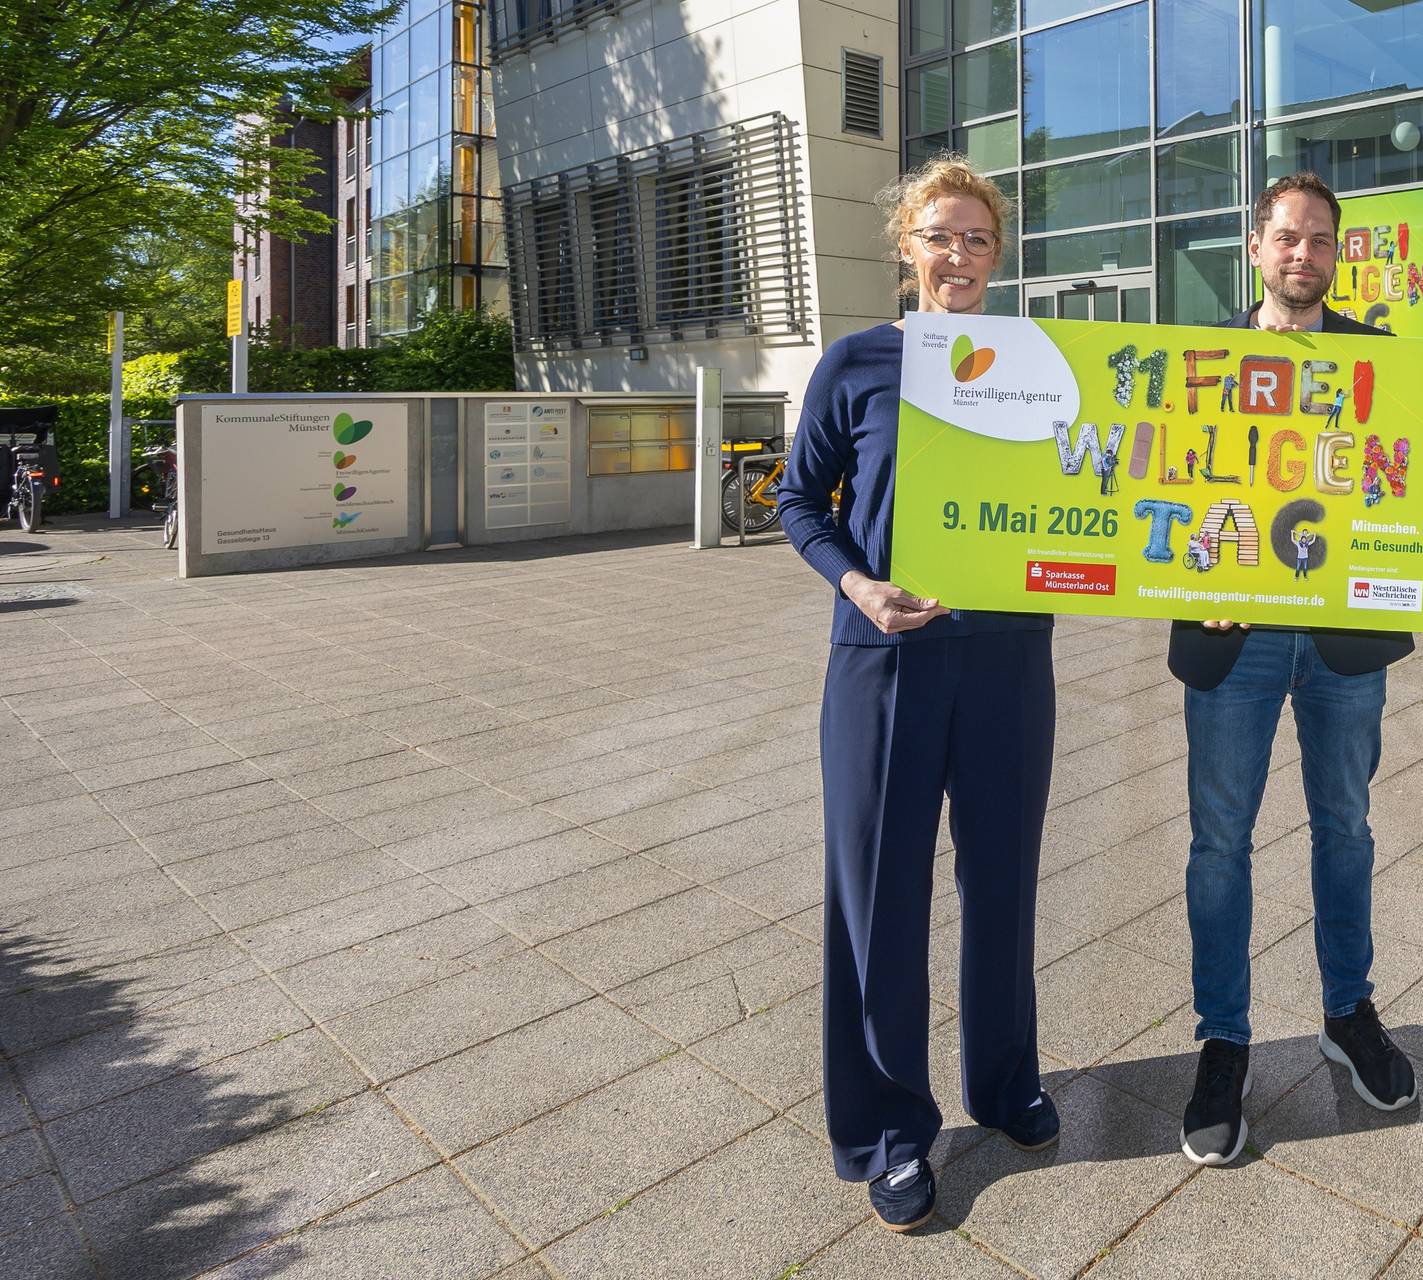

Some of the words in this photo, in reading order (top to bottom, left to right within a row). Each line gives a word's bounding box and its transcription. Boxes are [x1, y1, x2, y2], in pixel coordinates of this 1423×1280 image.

[1345, 223, 1409, 262] REI
[923, 332, 949, 342] Stiftung
[921, 340, 948, 349] Siverdes
[1183, 349, 1375, 424] FREI
[953, 385, 1063, 404] FreiwilligenAgentur
[952, 398, 979, 407] Münster
[215, 413, 330, 424] KommunaleStiftungen
[288, 423, 330, 432] Münster
[1052, 420, 1409, 499] WILLIGEN
[943, 501, 967, 530] 9.
[978, 502, 1037, 533] Mai
[1047, 506, 1119, 538] 2026
[1351, 519, 1420, 535] Mitmachen.
[1134, 498, 1328, 571] TAG
[1350, 538, 1370, 551] Am
[1045, 570, 1086, 581] Sparkasse
[1045, 580, 1094, 591] Münsterland
[1095, 583, 1110, 591] Ost
[1354, 587, 1369, 598] WN
[1372, 584, 1417, 593] Westfälische
[1137, 585, 1326, 607] freiwilligenagentur-muenster.de
[1372, 590, 1417, 600] Nachrichten
